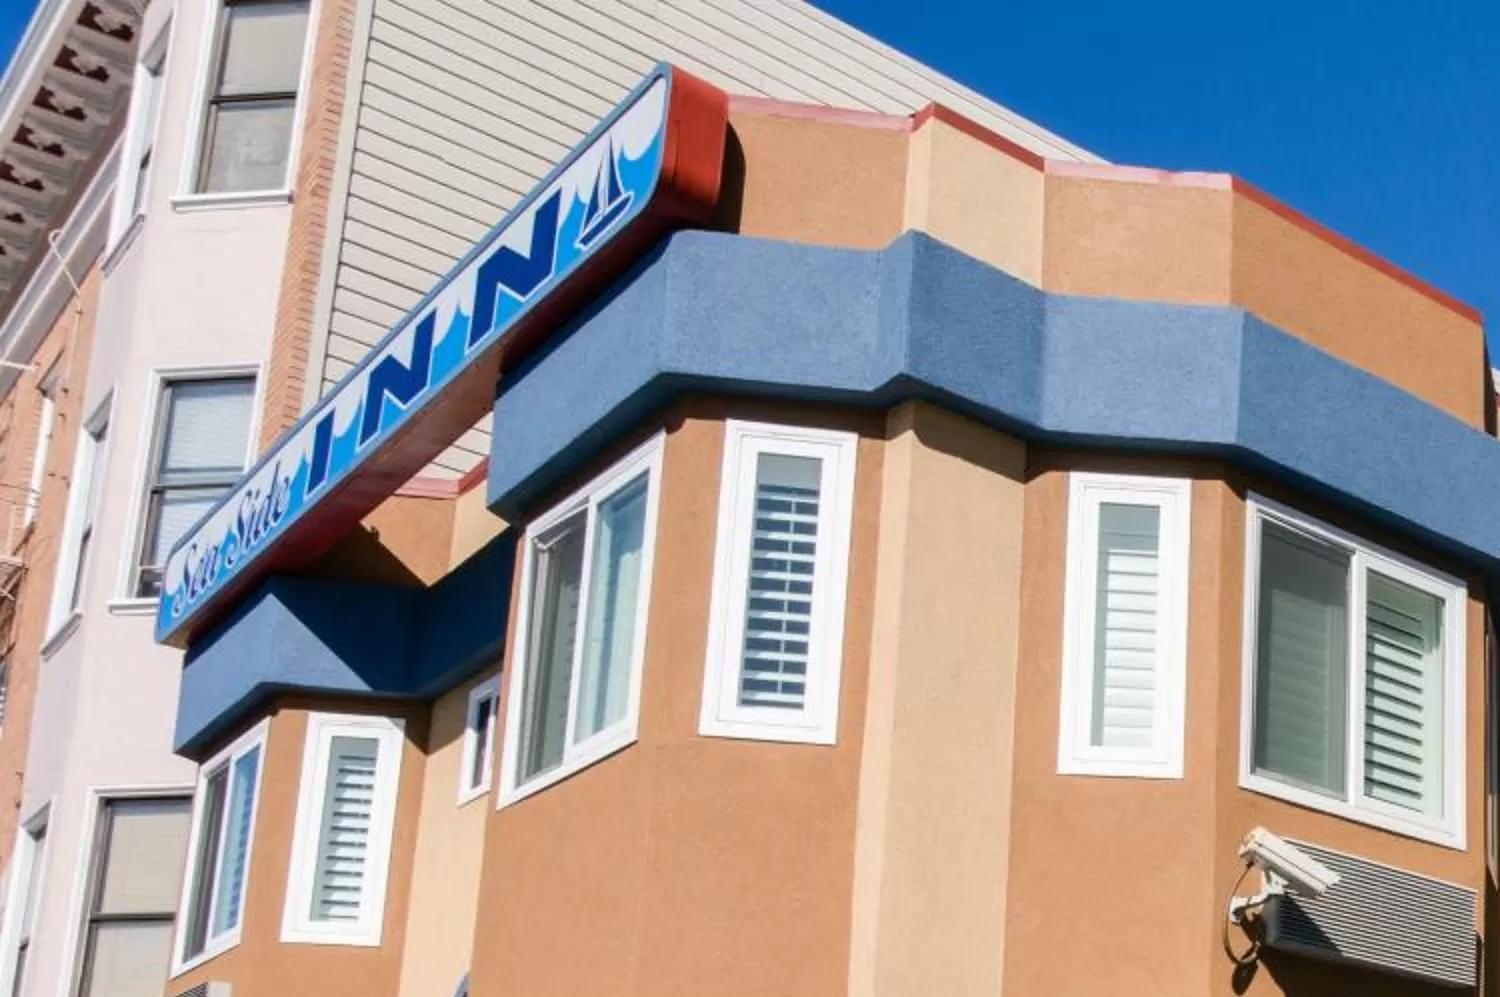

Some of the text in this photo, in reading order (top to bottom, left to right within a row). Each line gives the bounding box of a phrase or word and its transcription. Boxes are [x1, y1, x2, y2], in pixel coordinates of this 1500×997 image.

[172, 186, 562, 617] Sea Side INN
